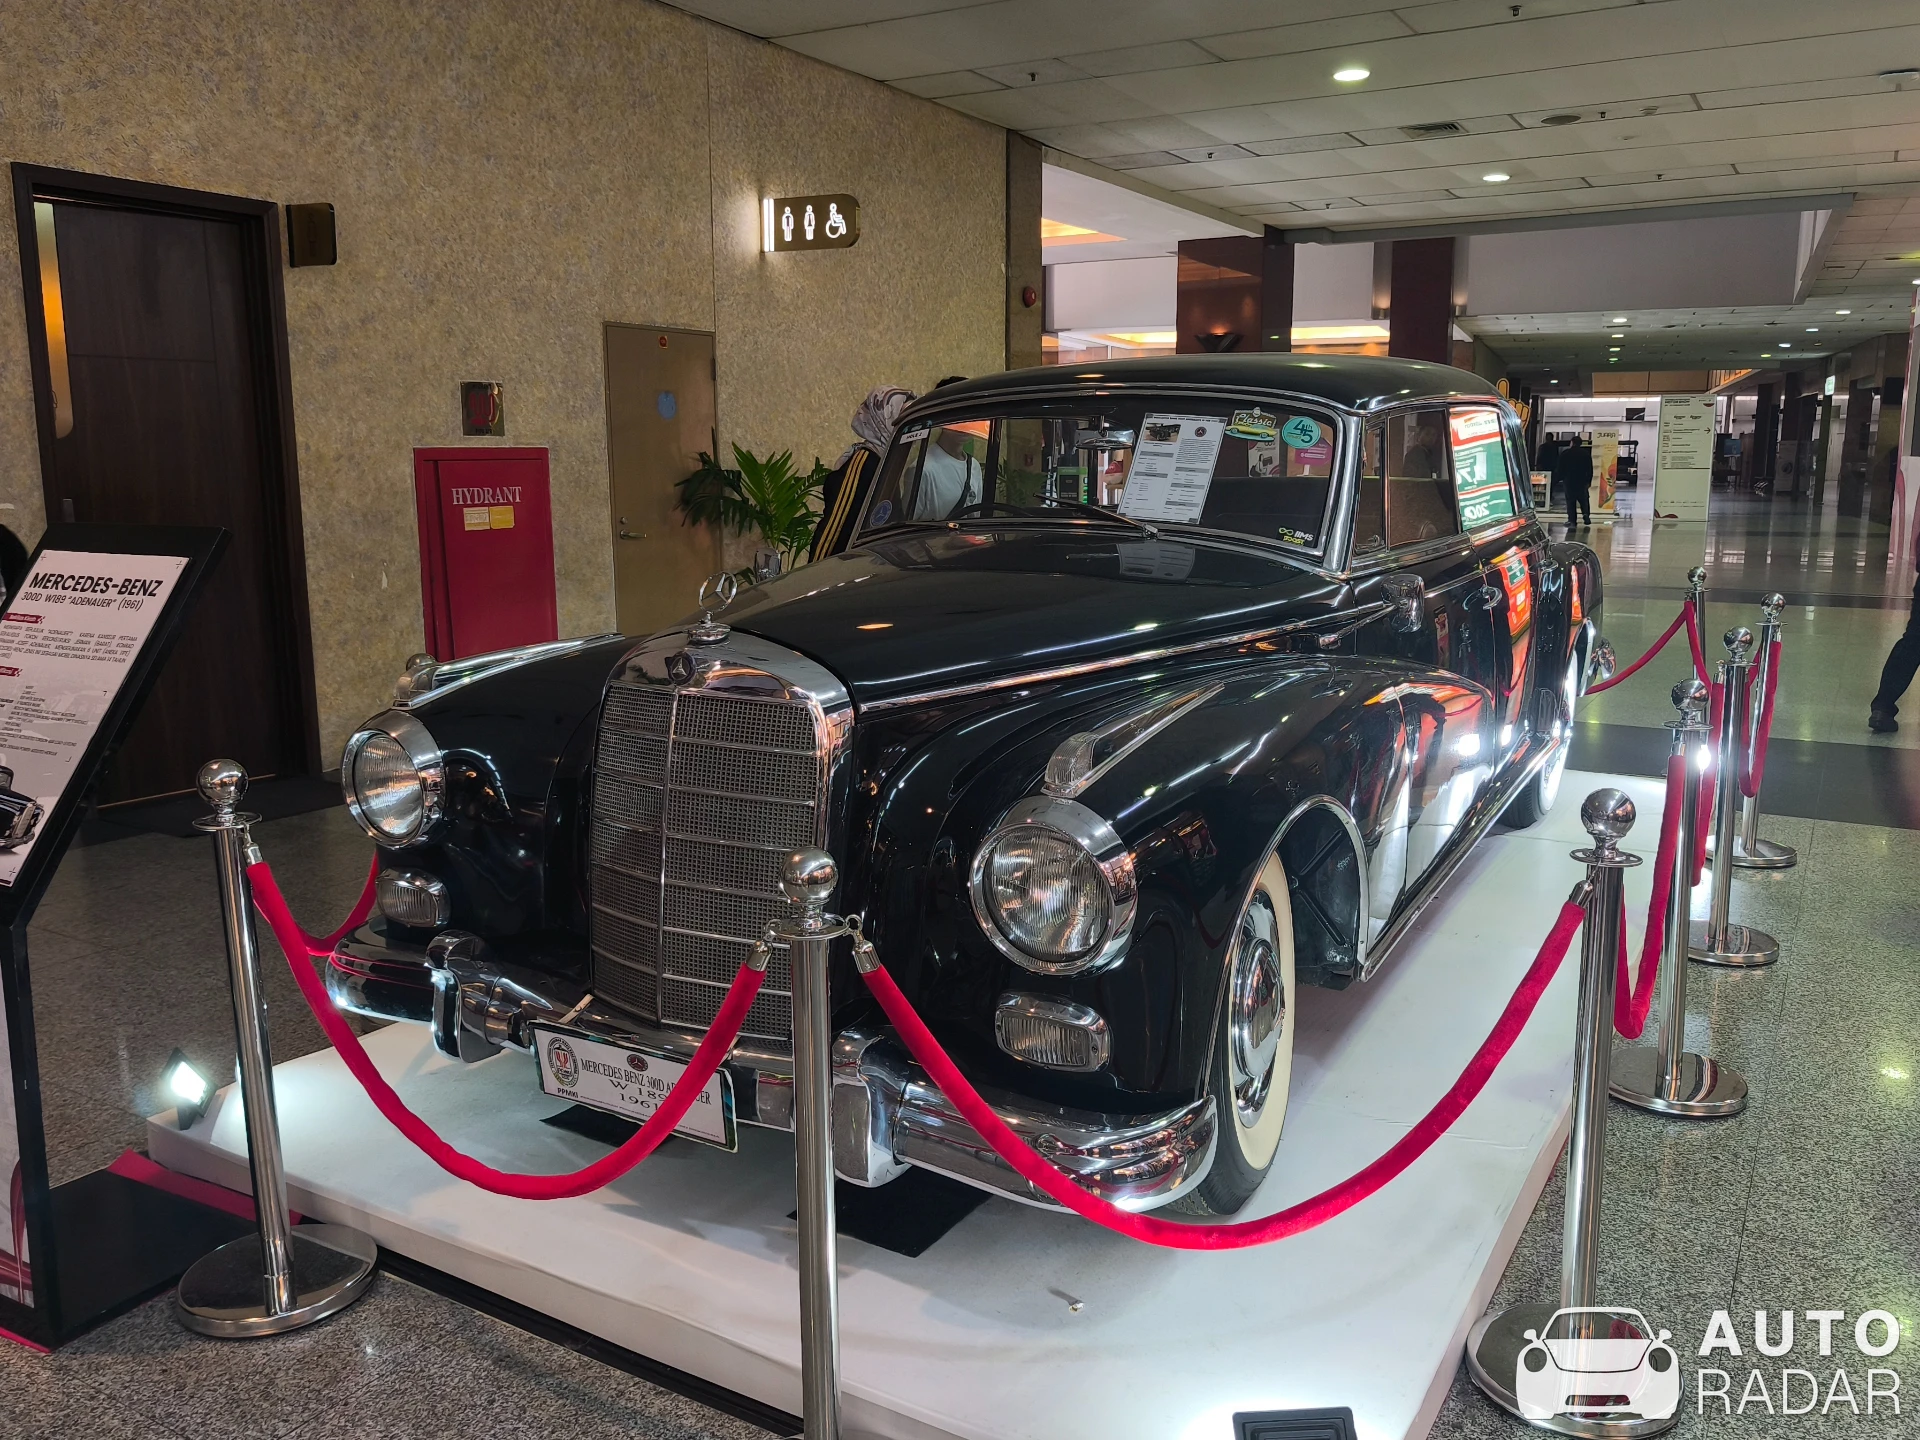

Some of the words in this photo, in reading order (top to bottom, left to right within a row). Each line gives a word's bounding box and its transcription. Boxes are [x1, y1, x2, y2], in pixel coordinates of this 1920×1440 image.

[452, 486, 522, 505] HYDRANT
[29, 572, 163, 597] MERCEDES-BENZ
[21, 592, 42, 602] 300D
[45, 594, 66, 604] W189
[118, 597, 144, 611] (1961)
[580, 1058, 623, 1080] MERCEDES
[625, 1070, 646, 1087] BENZ
[646, 1075, 665, 1092] 300D
[609, 1079, 629, 1090] W
[619, 1093, 659, 1110] 1961
